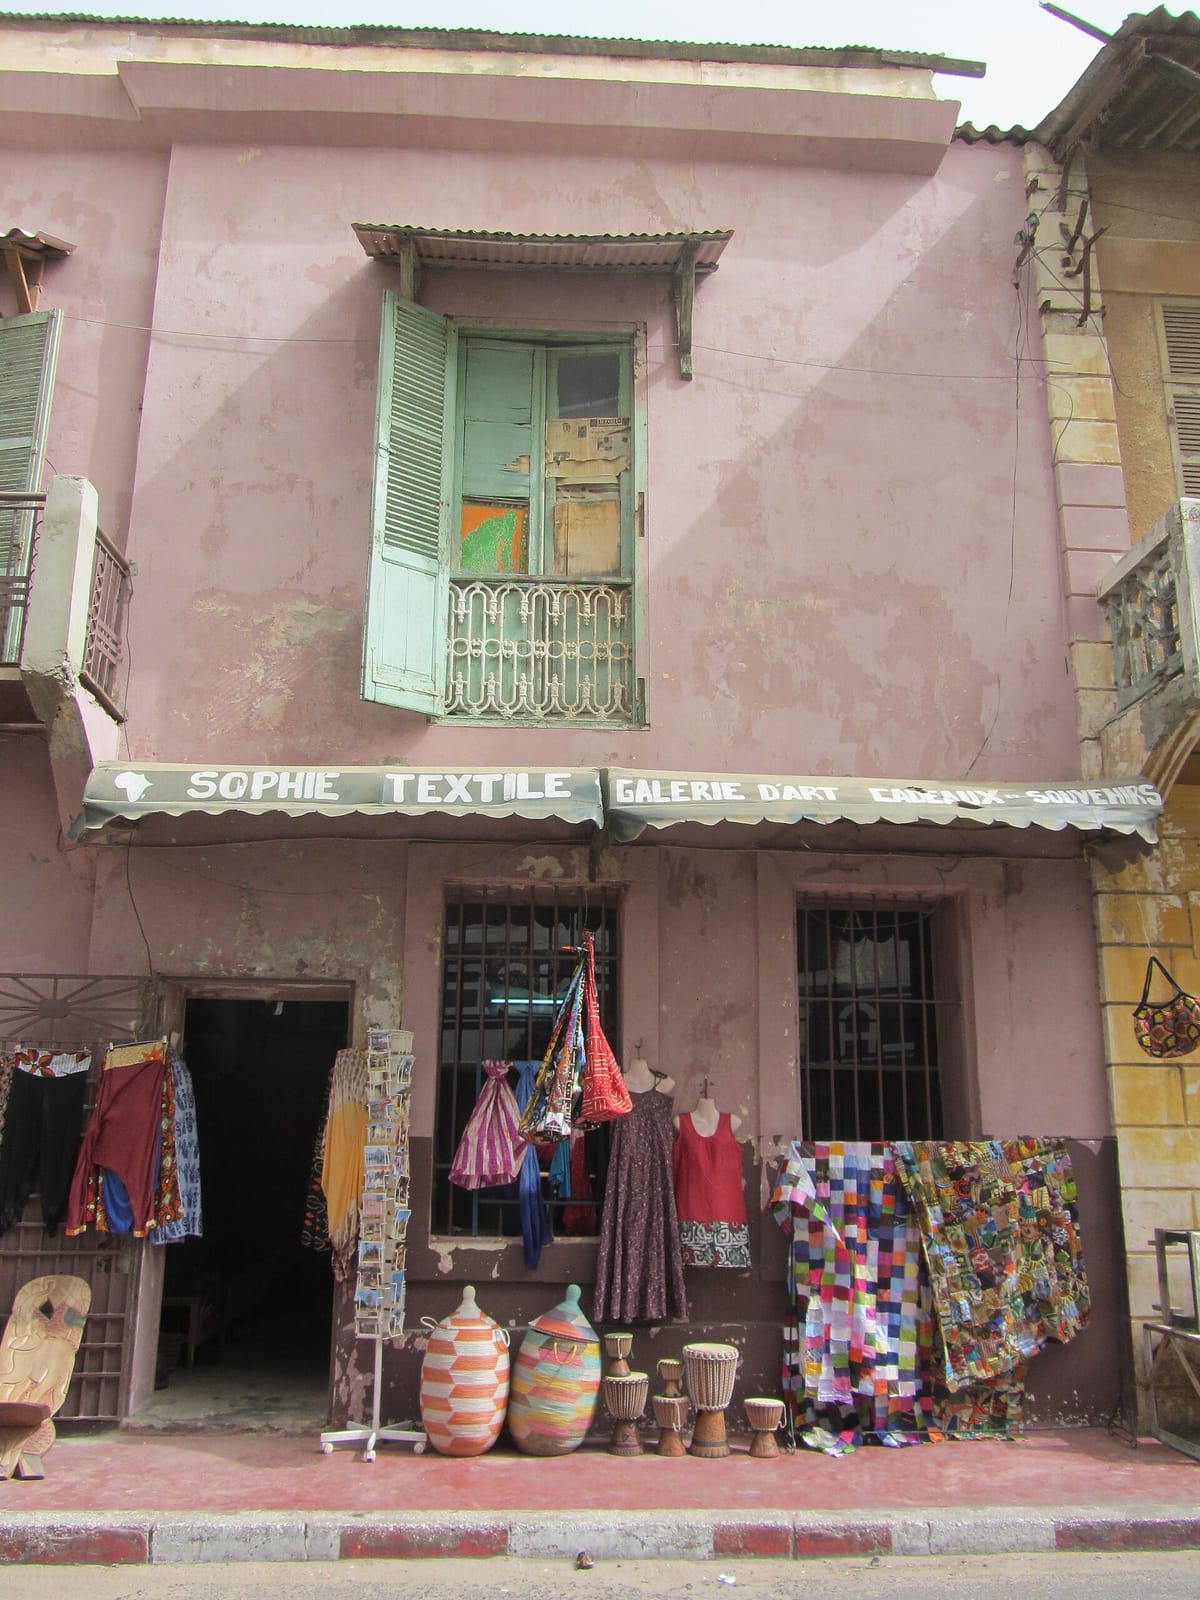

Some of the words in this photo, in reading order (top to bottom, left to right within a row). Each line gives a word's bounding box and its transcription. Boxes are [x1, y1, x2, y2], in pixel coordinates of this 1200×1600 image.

[187, 771, 340, 800] SOPHIE
[385, 772, 572, 803] TEXTILE
[616, 779, 746, 803] GALERIE
[757, 783, 839, 801] D'ART
[868, 788, 1006, 805] CADEAUX
[1025, 784, 1162, 806] SOUVENIRS
